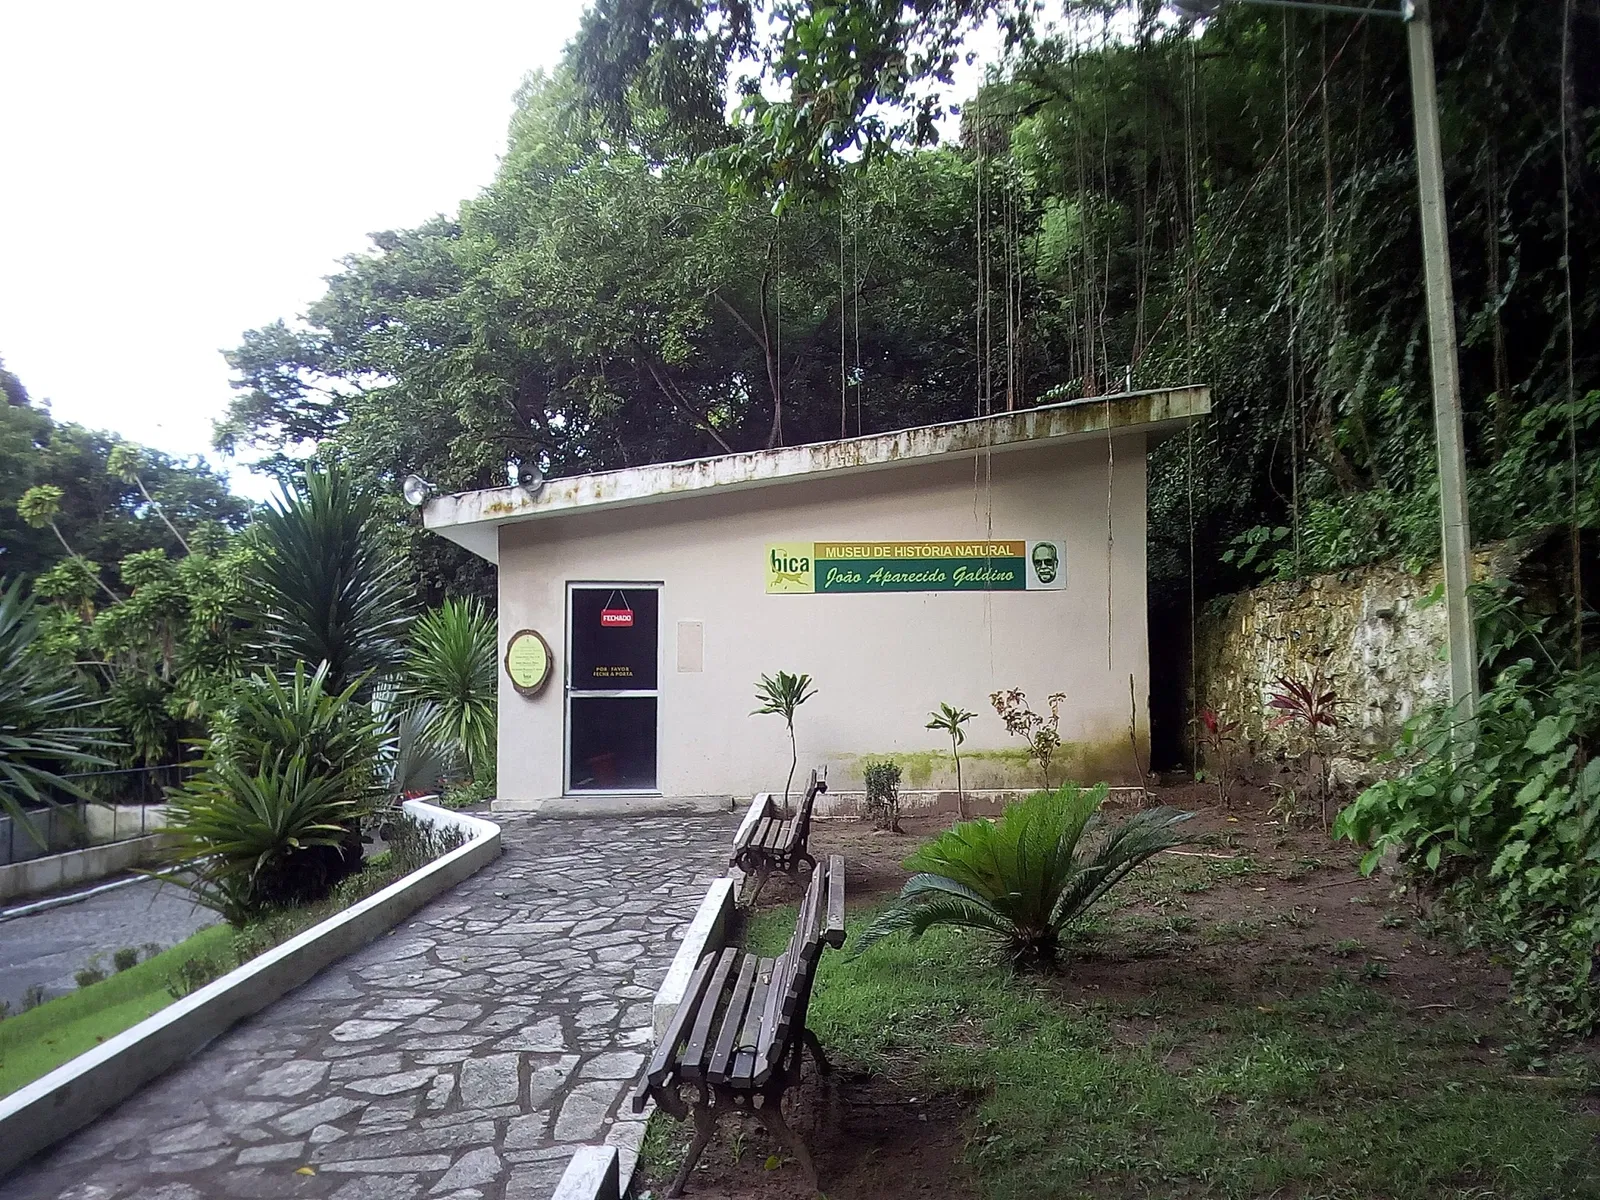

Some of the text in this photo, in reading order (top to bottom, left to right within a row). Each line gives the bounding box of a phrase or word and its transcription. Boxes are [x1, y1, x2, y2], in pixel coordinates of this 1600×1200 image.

[771, 549, 809, 573] bica
[825, 543, 1014, 558] MUSEU DE HISTÓRIA NATURAL
[824, 566, 1015, 588] João Aparecido Galdino
